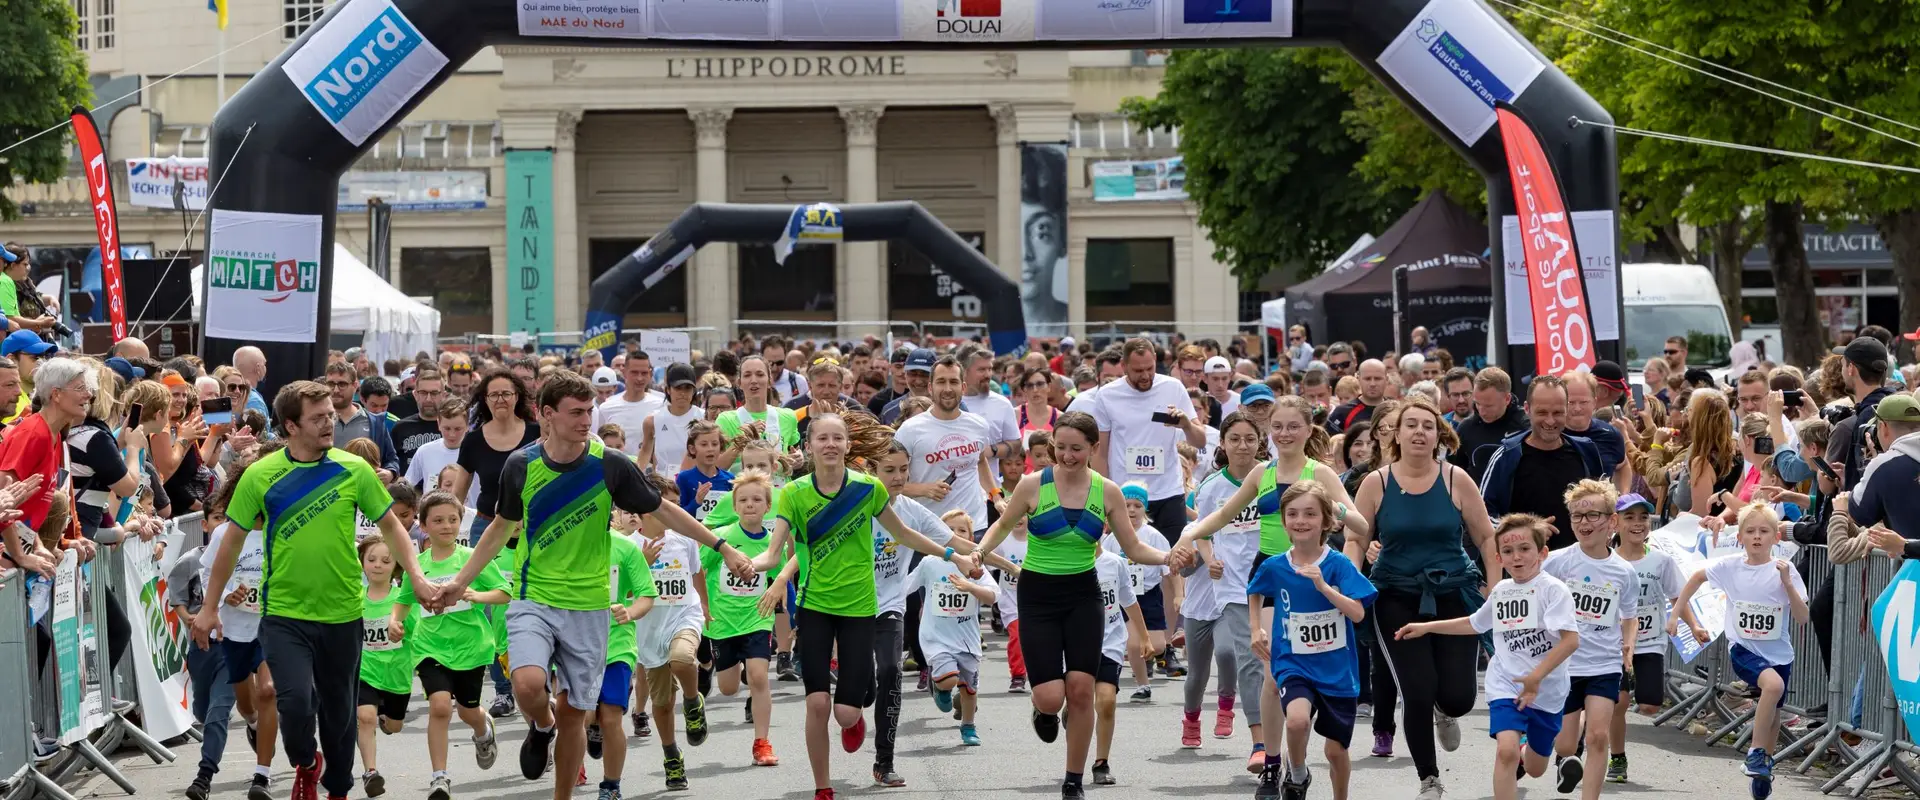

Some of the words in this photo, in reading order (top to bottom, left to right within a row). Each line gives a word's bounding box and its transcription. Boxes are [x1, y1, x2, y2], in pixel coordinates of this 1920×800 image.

[522, 3, 538, 11] Qui
[540, 4, 560, 12] aime
[586, 5, 618, 14] protège
[541, 17, 567, 27] MAE
[572, 18, 588, 28] du
[593, 19, 625, 29] Nord
[937, 19, 1002, 34] DOUAI
[1440, 35, 1465, 60] Région
[313, 14, 407, 108] Nord
[666, 55, 907, 79] L'HIPPODROME
[1443, 253, 1480, 266] Jean
[211, 258, 317, 291] MATCH
[1136, 454, 1156, 467] 401
[1229, 505, 1261, 523] 422
[654, 579, 687, 596] 3168
[938, 592, 969, 608] 3167
[1496, 599, 1529, 620] 3100
[1739, 612, 1775, 631] 3139
[1299, 621, 1338, 643] 3011
[1508, 629, 1548, 653] GAYANT
[1529, 640, 1553, 658] 2022
